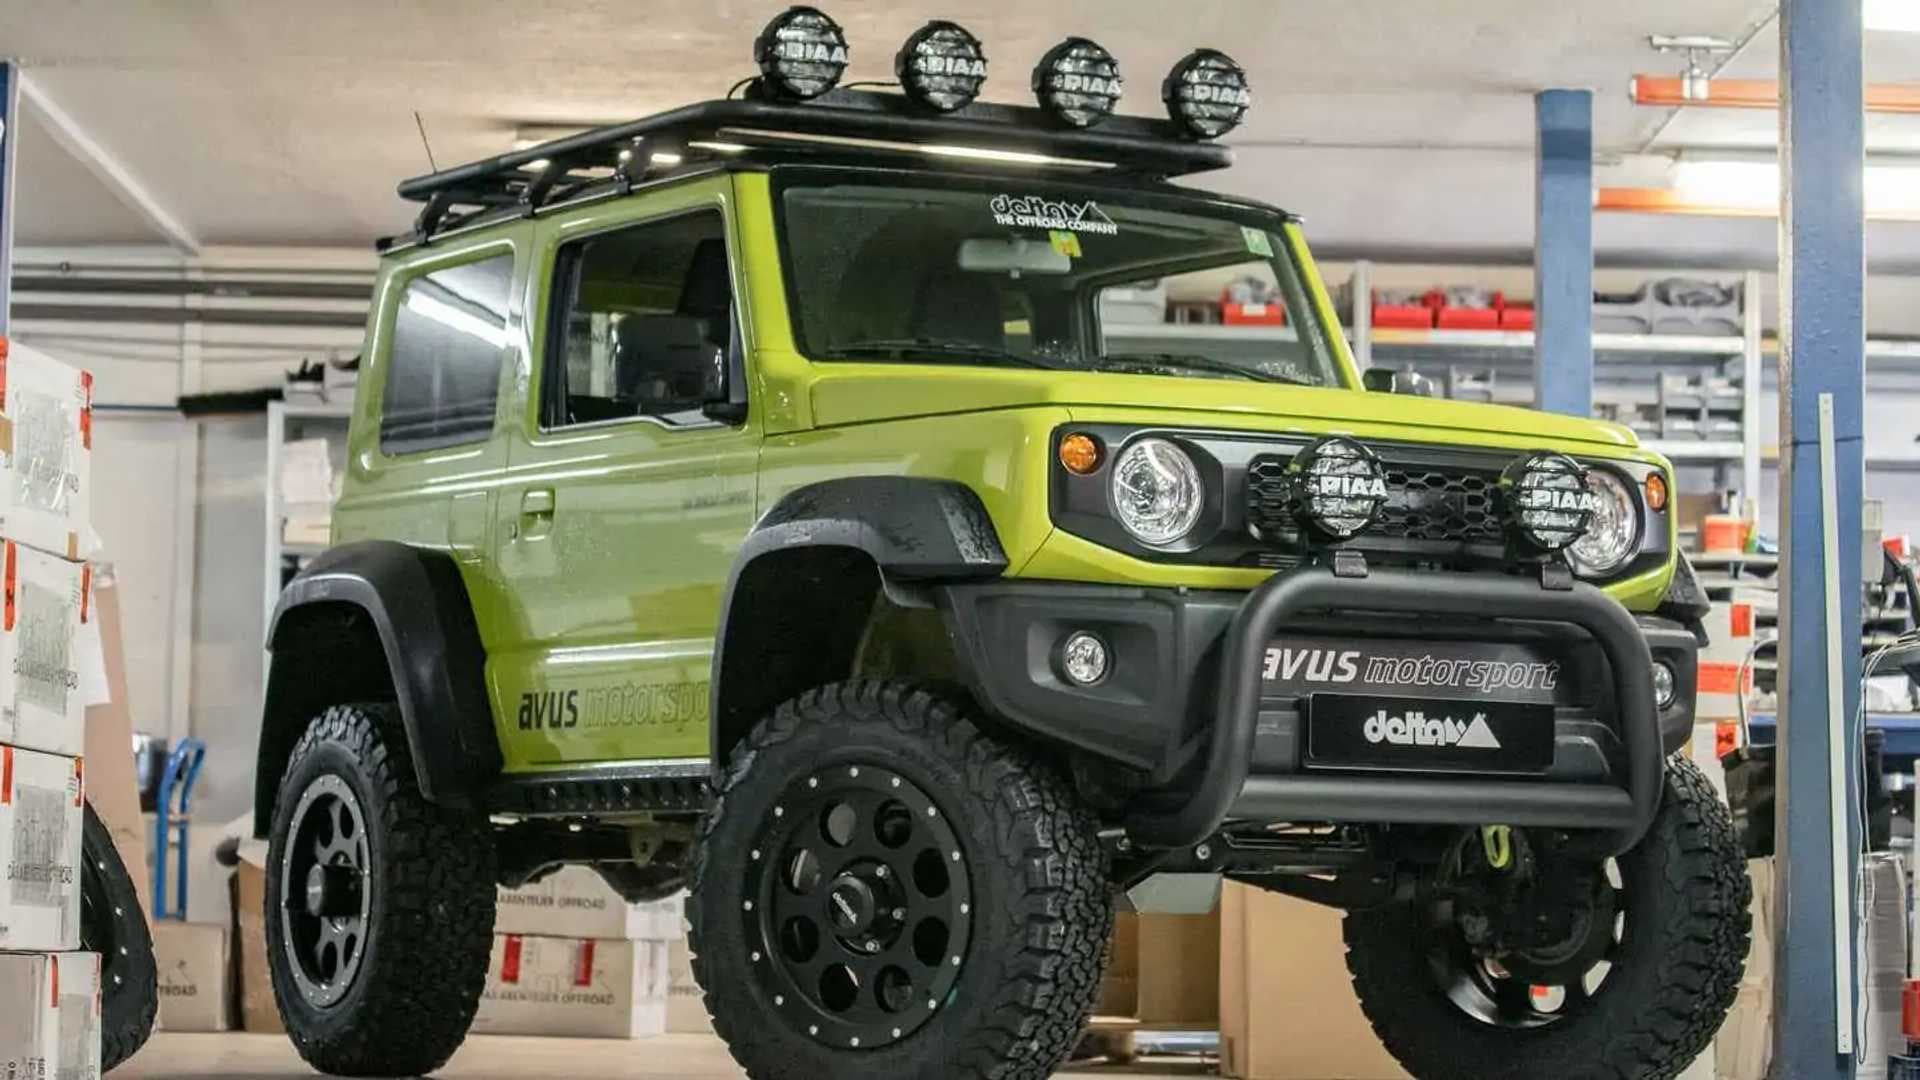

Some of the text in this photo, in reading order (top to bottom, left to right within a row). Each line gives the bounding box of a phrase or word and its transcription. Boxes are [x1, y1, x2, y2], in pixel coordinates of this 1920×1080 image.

[786, 41, 848, 64] PIAA
[926, 56, 986, 77] PIAA
[1063, 74, 1122, 96] PIAA
[1193, 84, 1250, 106] PIAA
[994, 213, 1118, 235] THE OFFROAD COMPANY
[1320, 475, 1387, 498] PIAA
[1531, 489, 1594, 511] PIAA
[1262, 647, 1561, 692] avus motorsport
[518, 680, 709, 732] avus motorspo
[558, 897, 606, 911] OFFROAD
[561, 993, 615, 1006] OFFROAD
